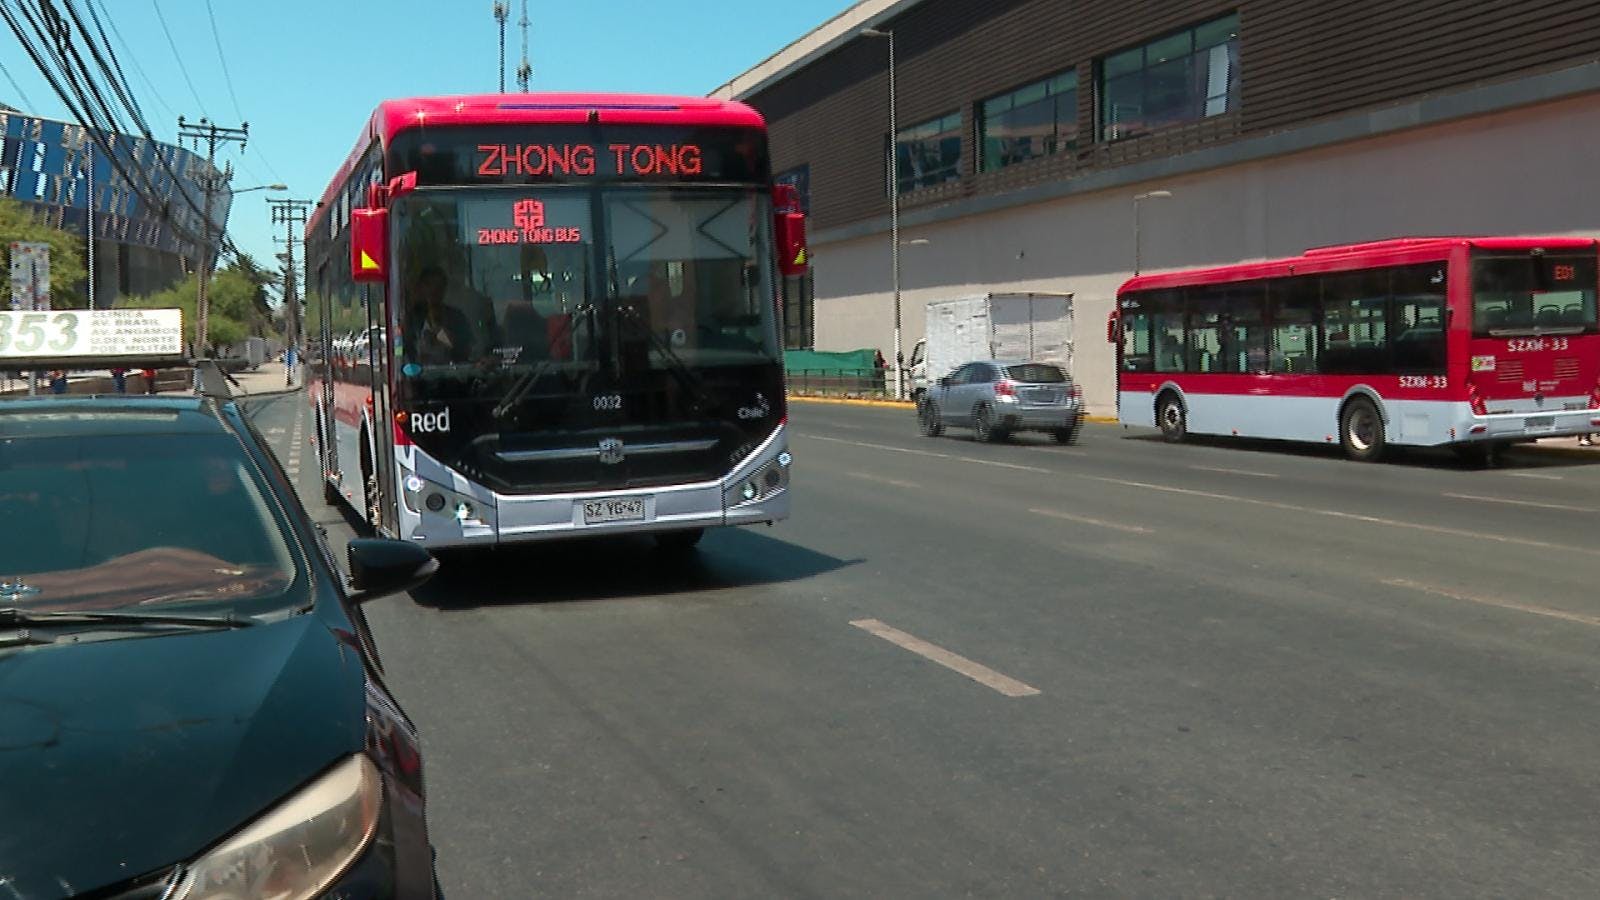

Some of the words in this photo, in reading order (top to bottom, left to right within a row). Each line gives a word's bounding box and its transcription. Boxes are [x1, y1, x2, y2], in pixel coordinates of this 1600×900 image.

[477, 143, 596, 175] ZHONG
[608, 143, 702, 175] TONG
[478, 229, 518, 244] ZHONG
[521, 227, 553, 243] TONG
[555, 226, 580, 242] BUS
[593, 395, 622, 410] 0032
